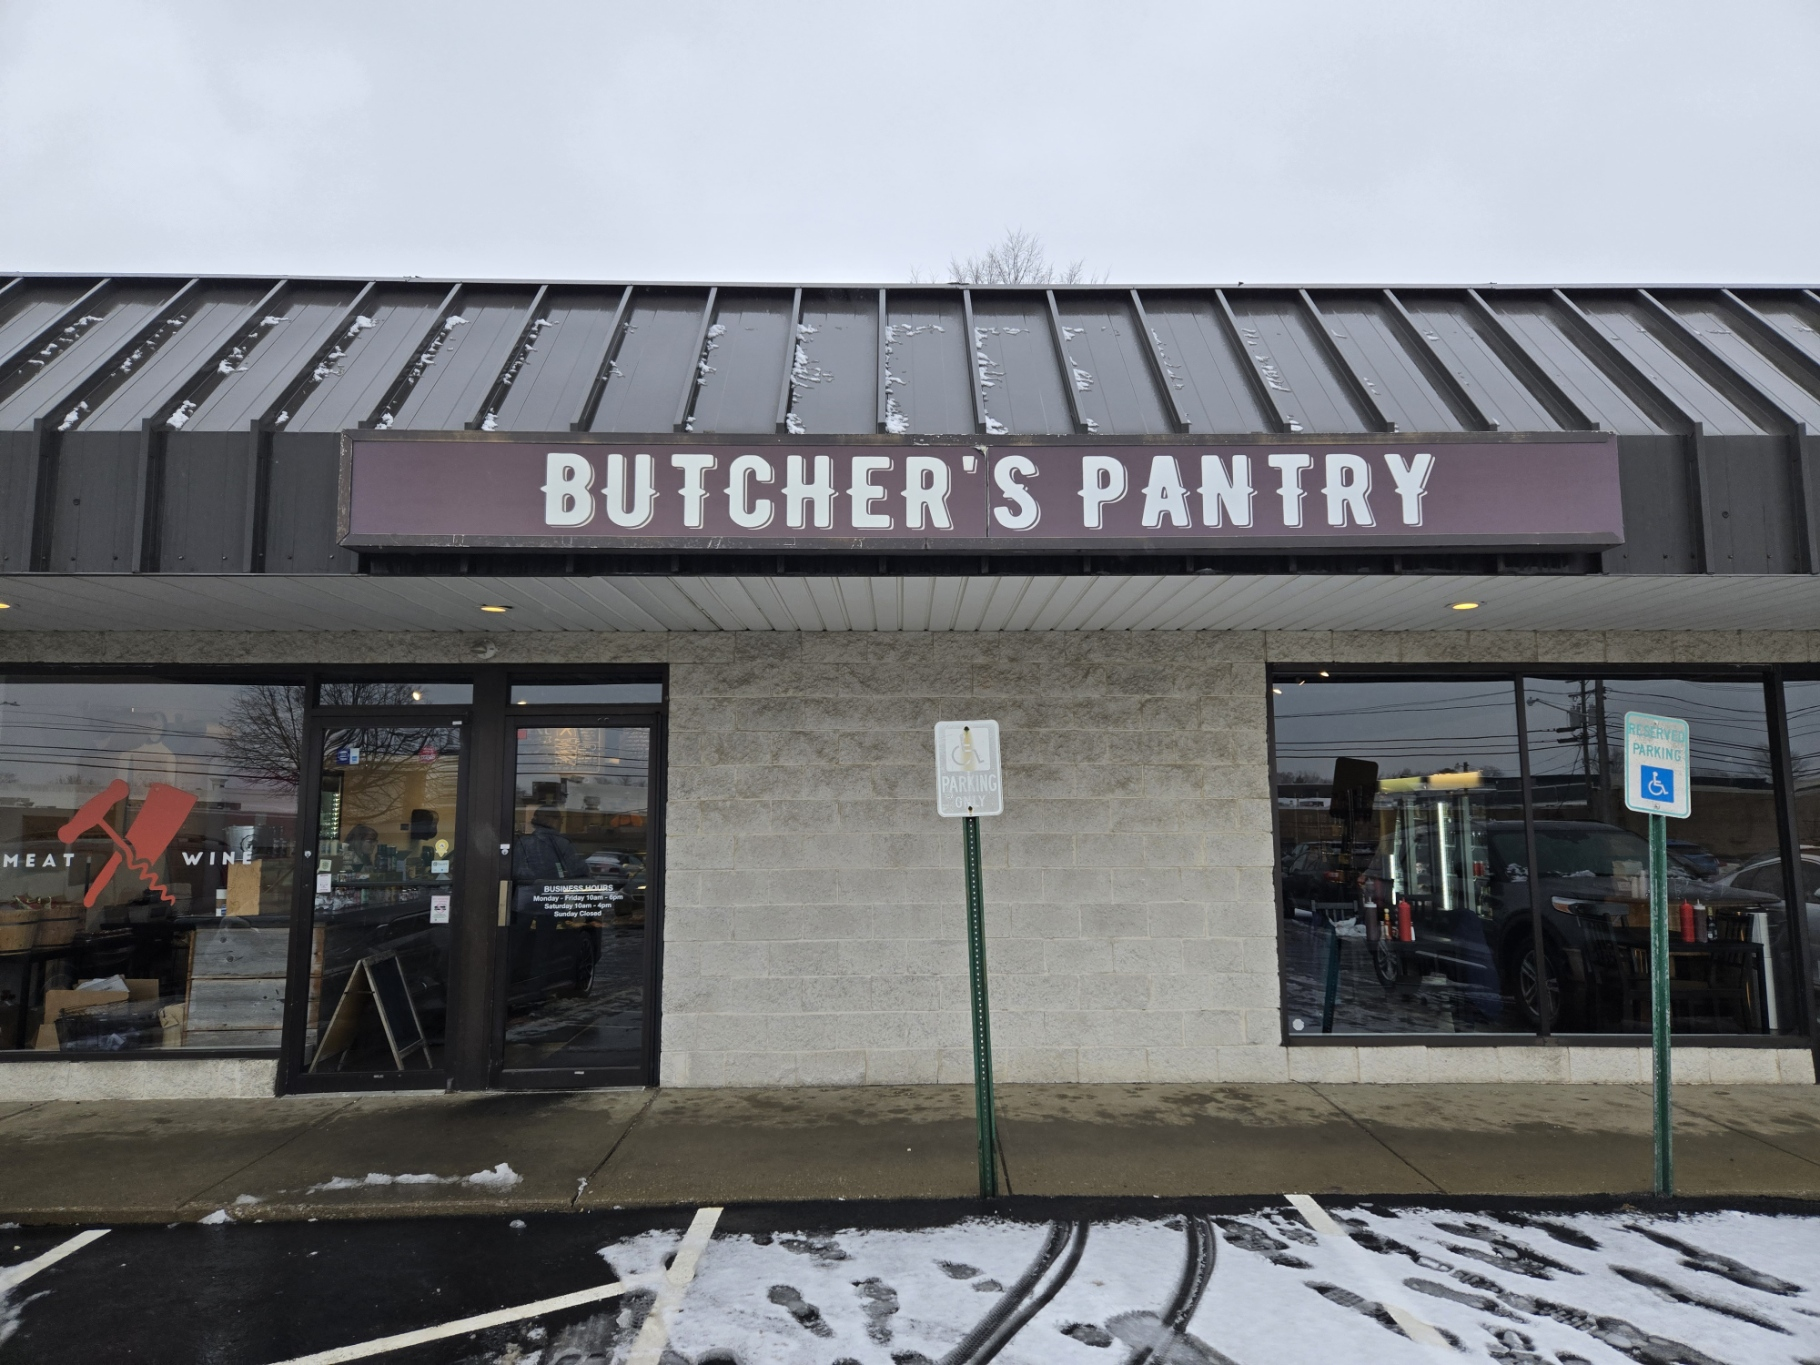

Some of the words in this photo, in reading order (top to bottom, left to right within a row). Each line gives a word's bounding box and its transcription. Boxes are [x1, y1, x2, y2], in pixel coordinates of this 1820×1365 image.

[540, 453, 1041, 531] BUTCHER'S
[1077, 453, 1436, 528] PANTRY
[1628, 722, 1685, 743] RESERVED
[1633, 742, 1682, 762] PARKING
[941, 774, 997, 793] PARKING
[955, 795, 986, 808] ONLY
[3, 853, 75, 867] MEAT
[182, 851, 253, 866] WINE
[543, 885, 584, 893] BUSINESS
[585, 884, 614, 892] HOURS
[564, 894, 585, 902] Friday
